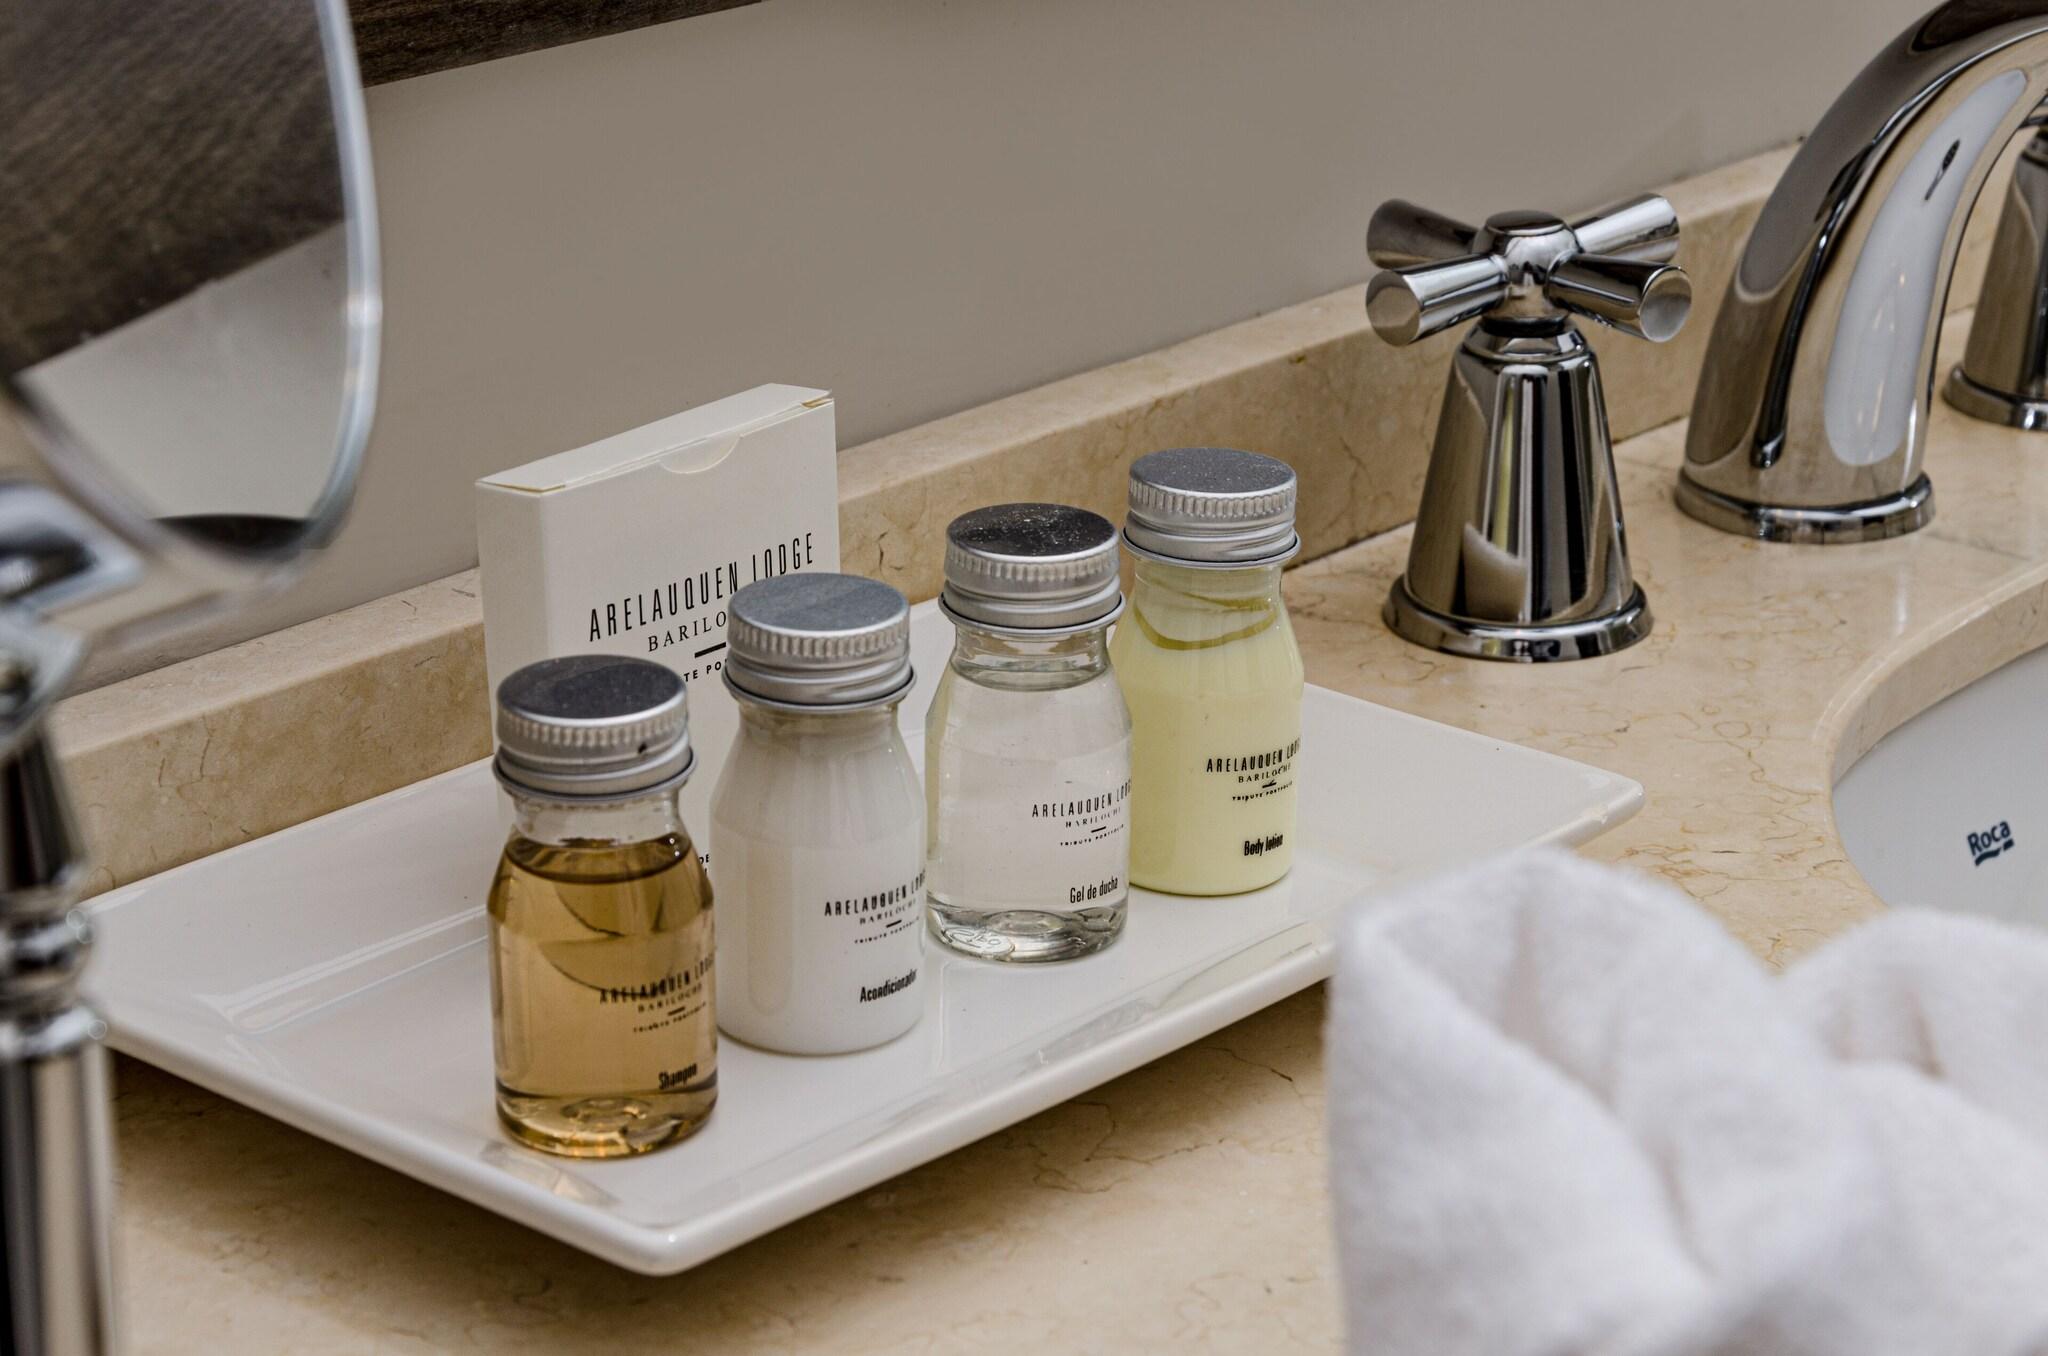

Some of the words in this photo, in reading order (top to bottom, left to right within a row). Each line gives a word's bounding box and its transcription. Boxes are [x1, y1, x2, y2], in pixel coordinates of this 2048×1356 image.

[589, 561, 738, 642] ARELAUQUEN
[752, 532, 813, 582] LODGE
[648, 610, 727, 652] BARILO
[1206, 749, 1283, 773] ARELAUQUEN
[1032, 793, 1112, 818] ARELAUQUEN
[1244, 838, 1264, 857] Body
[1967, 820, 2011, 857] Roca
[824, 884, 907, 917] ARELAUQUEN
[1070, 885, 1085, 904] Gel
[1087, 883, 1097, 900] de
[1099, 875, 1119, 897] ducha
